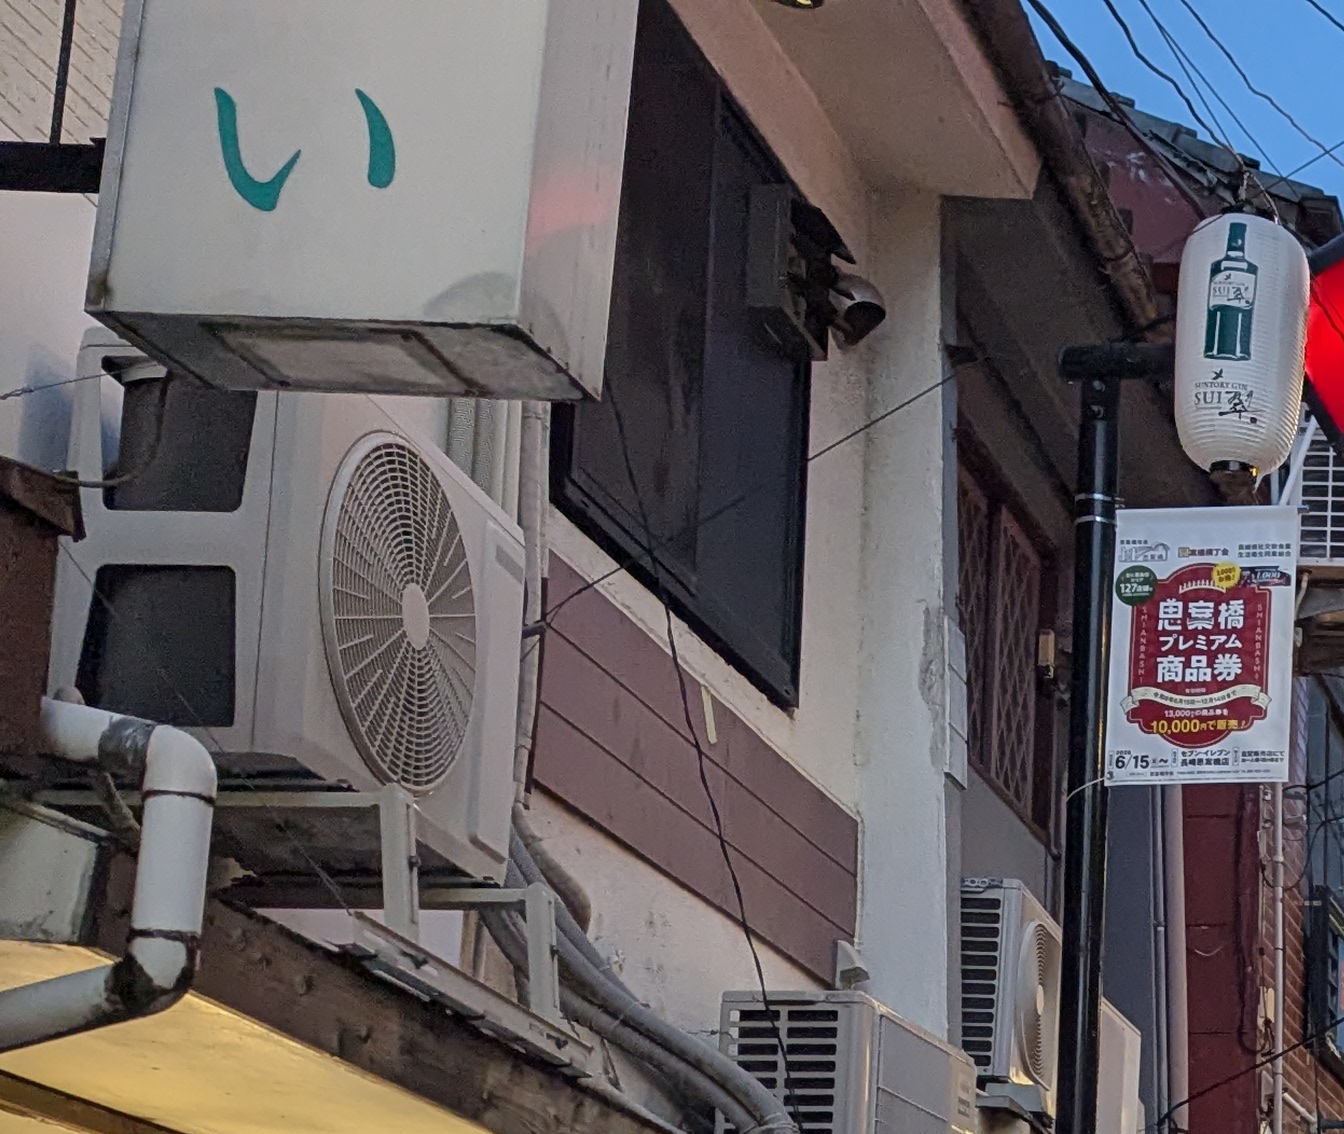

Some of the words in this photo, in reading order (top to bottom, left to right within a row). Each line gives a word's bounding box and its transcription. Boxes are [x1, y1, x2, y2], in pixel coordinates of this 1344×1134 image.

[214, 87, 396, 212] い
[1195, 391, 1222, 406] SUI
[1157, 598, 1245, 631] 思案橋
[1159, 633, 1243, 651] プレミアム
[1157, 655, 1243, 684] 商品券
[1115, 755, 1150, 769] 6/15
